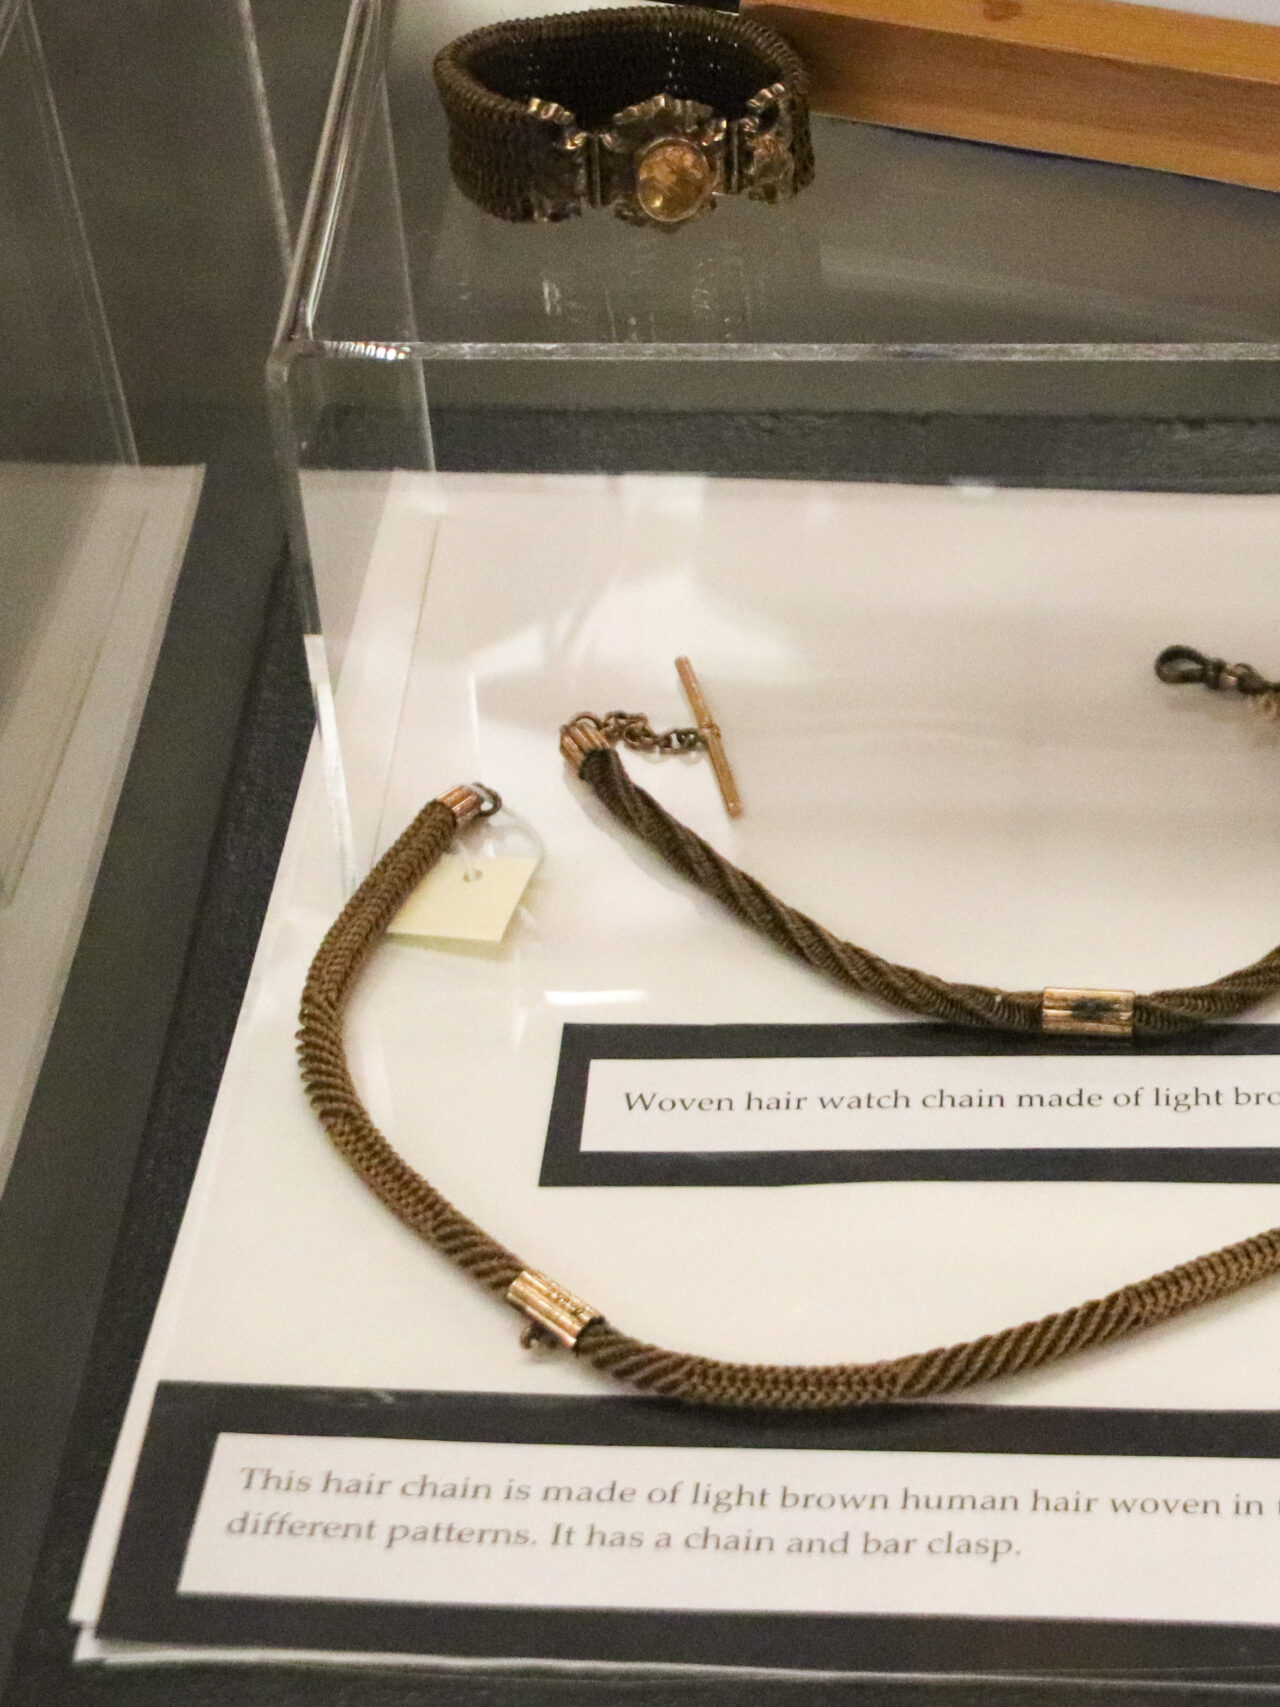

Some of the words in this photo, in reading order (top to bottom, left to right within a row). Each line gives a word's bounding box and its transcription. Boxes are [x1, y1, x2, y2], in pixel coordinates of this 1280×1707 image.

[624, 1092, 734, 1112] Woven
[745, 1091, 808, 1111] hair
[818, 1088, 911, 1110] watch
[921, 1088, 1005, 1109] chain
[1017, 1087, 1103, 1108] made
[1112, 1086, 1144, 1107] of
[1153, 1086, 1223, 1113] light
[240, 1467, 313, 1493] This
[321, 1470, 393, 1496] hair
[399, 1474, 491, 1499] chain
[502, 1478, 532, 1501] is
[541, 1480, 638, 1504] made
[647, 1481, 685, 1506] of
[691, 1482, 770, 1513] light
[780, 1485, 889, 1510] brown
[900, 1487, 1019, 1512] human
[1030, 1489, 1098, 1514] hair
[1110, 1498, 1221, 1516] woven
[1233, 1494, 1264, 1516] in
[226, 1508, 377, 1540] different
[384, 1520, 538, 1550] patterns.
[550, 1523, 574, 1547] It
[585, 1523, 644, 1549] has
[654, 1532, 672, 1549] a
[684, 1526, 776, 1553] chain
[786, 1530, 850, 1555] and
[862, 1531, 918, 1555] bar
[927, 1531, 1022, 1564] clasp.
